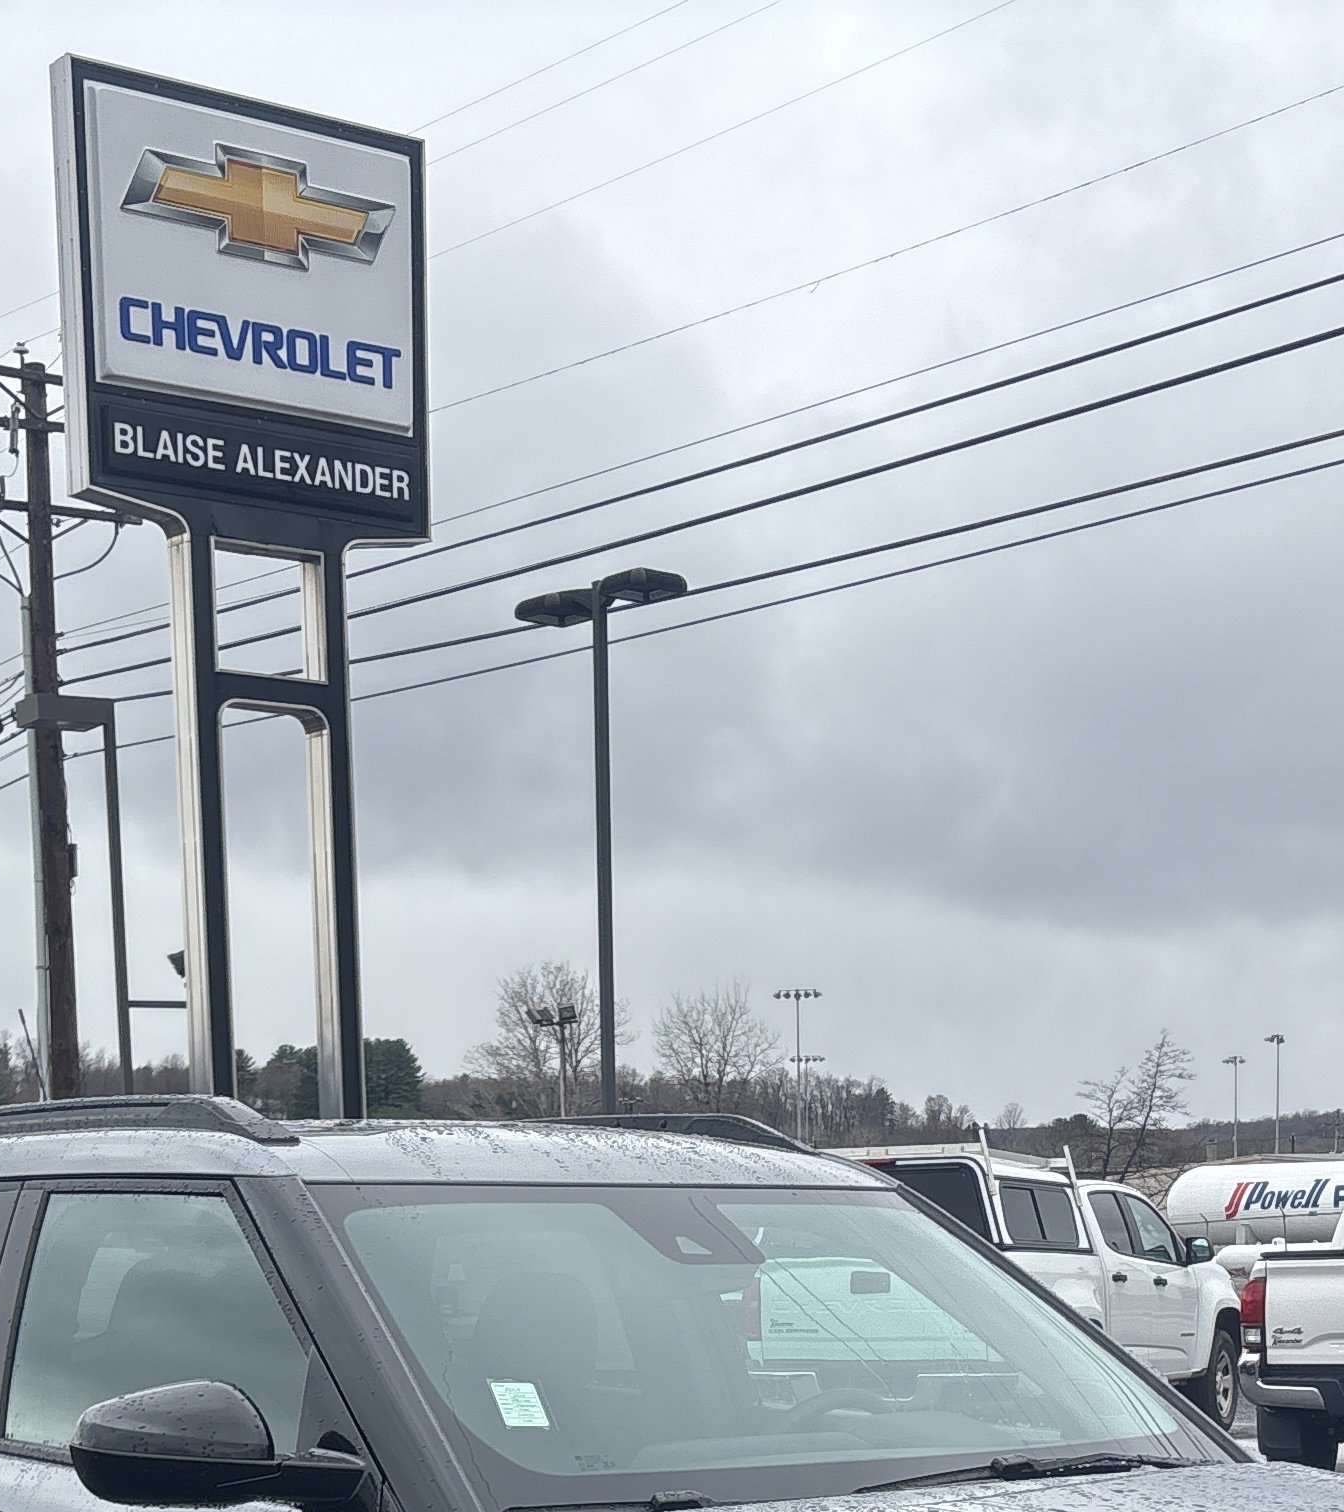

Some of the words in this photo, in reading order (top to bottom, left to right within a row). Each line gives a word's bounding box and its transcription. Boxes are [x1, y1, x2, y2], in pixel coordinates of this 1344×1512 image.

[119, 296, 401, 389] CHEVROLET
[114, 421, 226, 470] BLAISE
[235, 443, 411, 500] ALEXANDER
[1243, 1178, 1331, 1210] Powell
